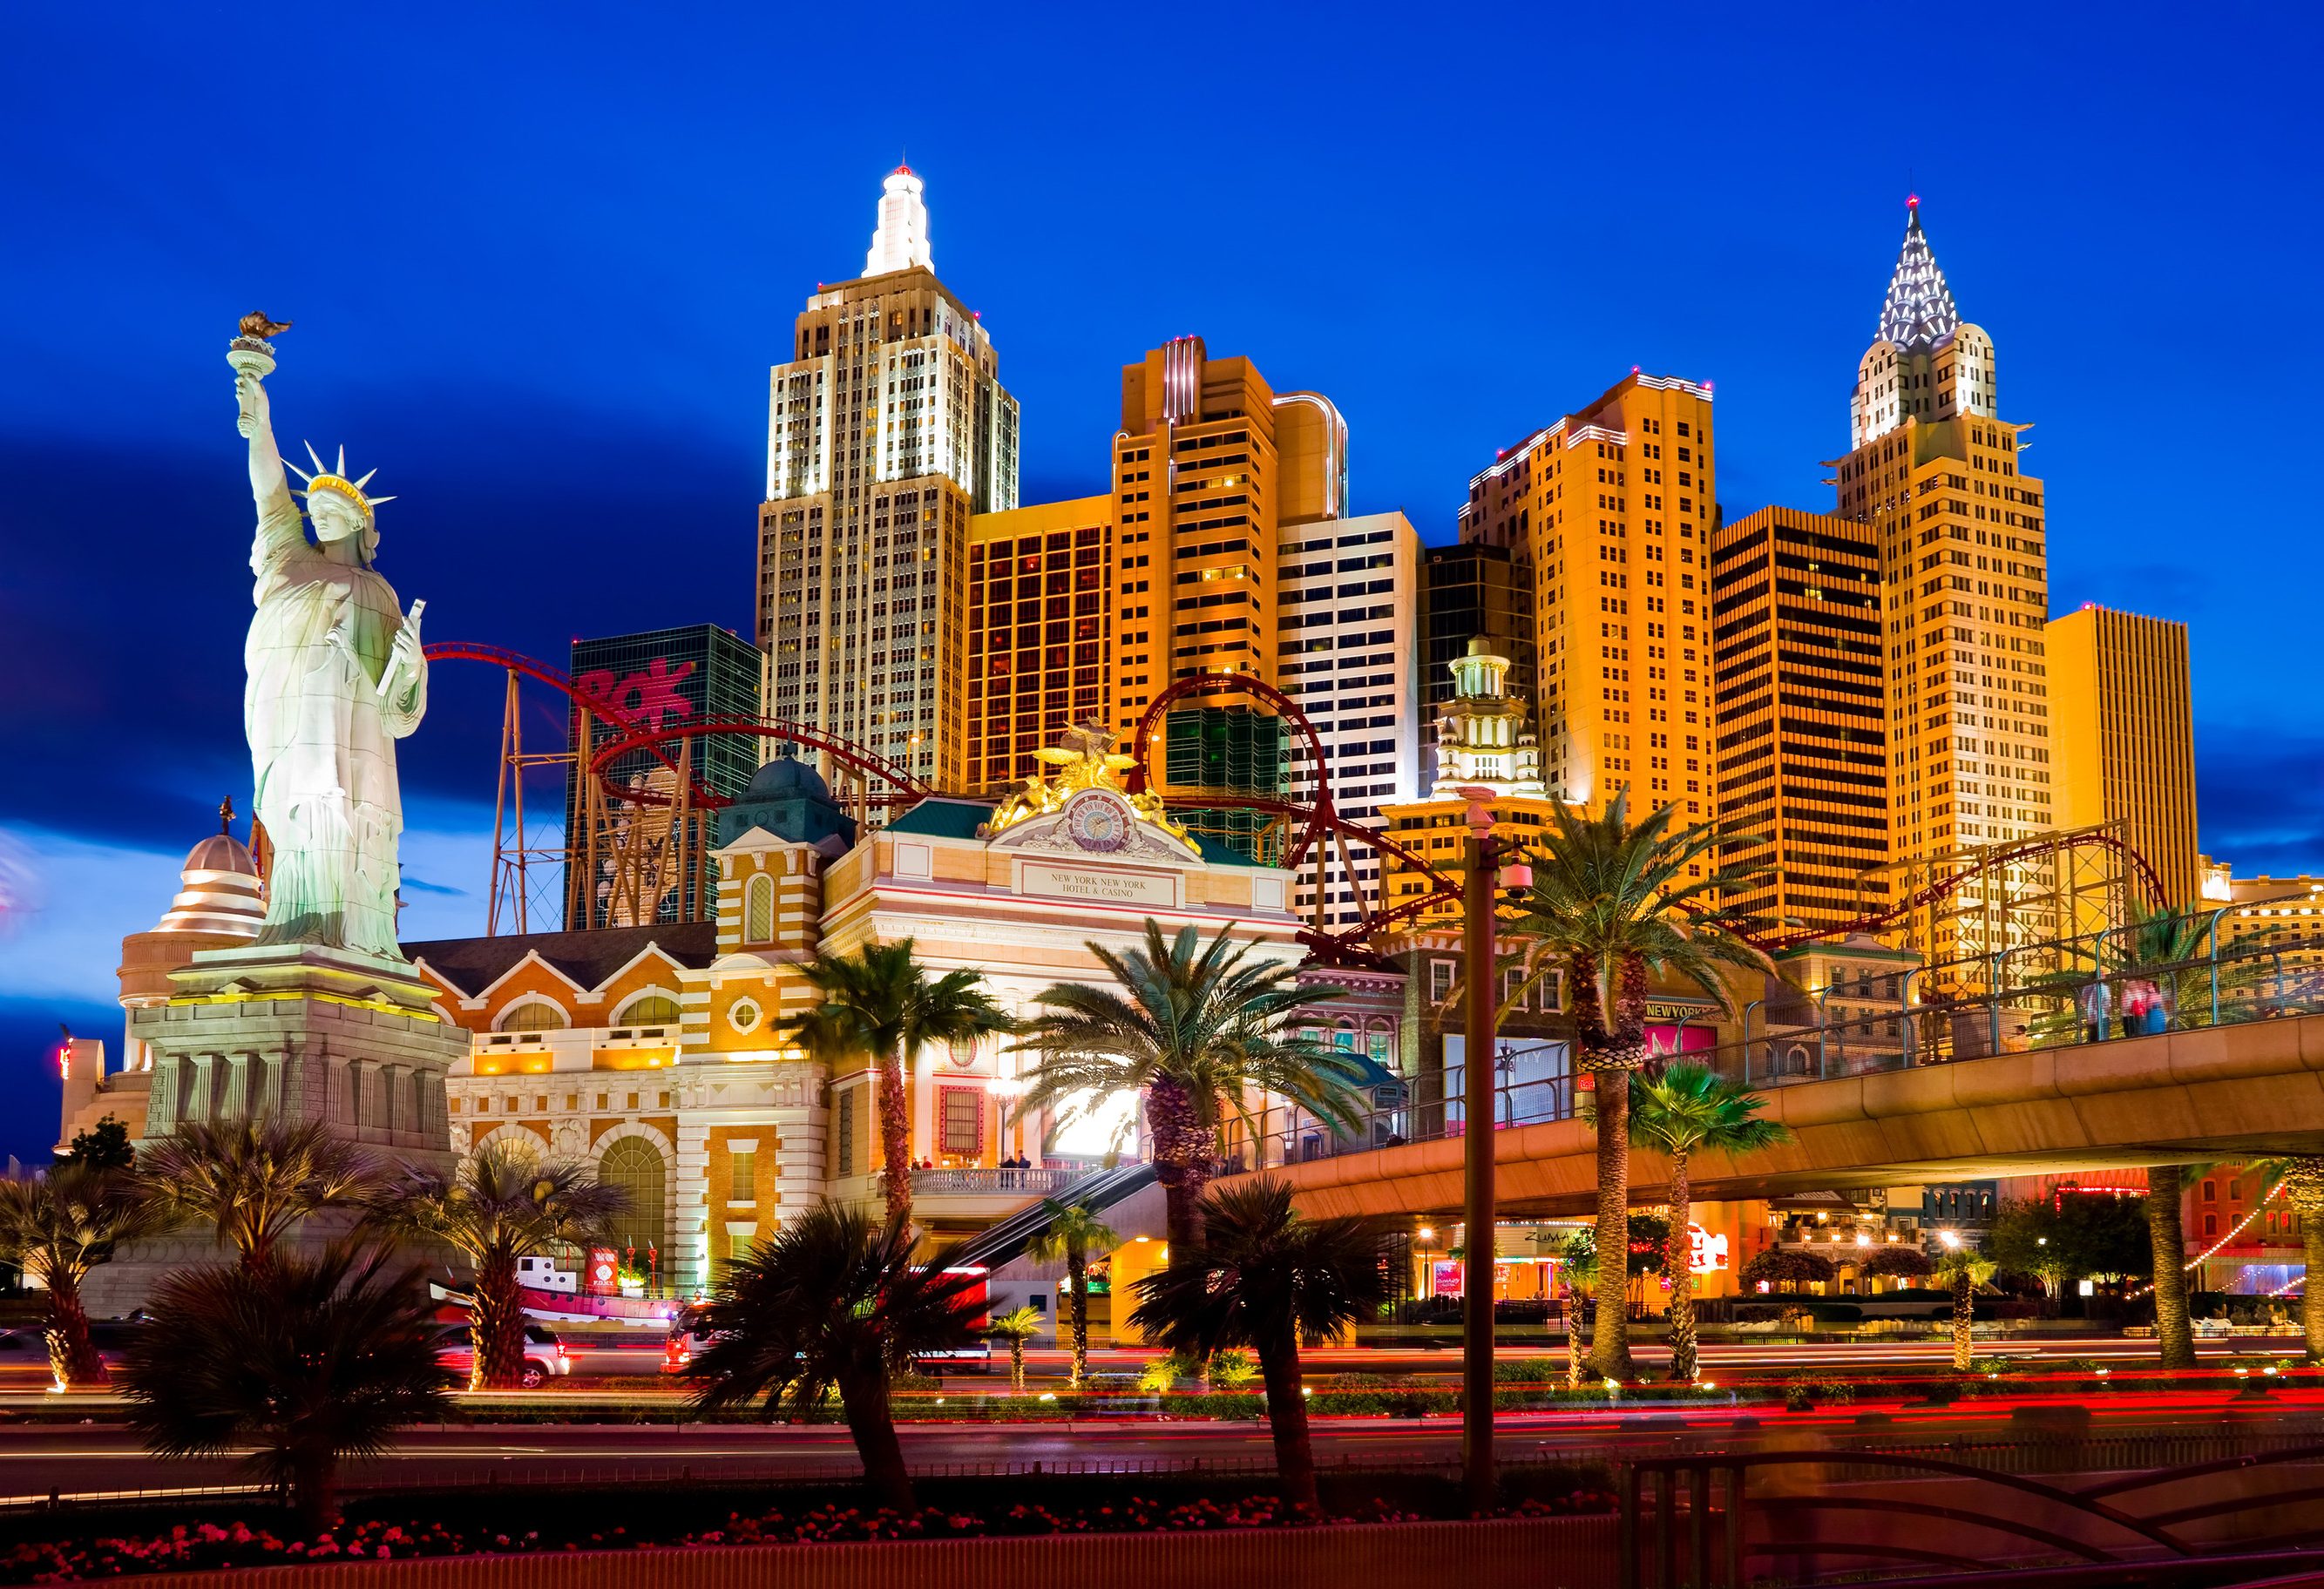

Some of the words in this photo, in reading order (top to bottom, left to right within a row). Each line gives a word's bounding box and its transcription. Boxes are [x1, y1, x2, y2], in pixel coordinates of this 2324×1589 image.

[1052, 874, 1071, 882] NEW
[1074, 876, 1097, 885] YORK
[1101, 878, 1121, 887] NEW
[1123, 880, 1146, 889] YORK
[1062, 884, 1090, 894] HOTEL
[1101, 889, 1133, 897] CASINO
